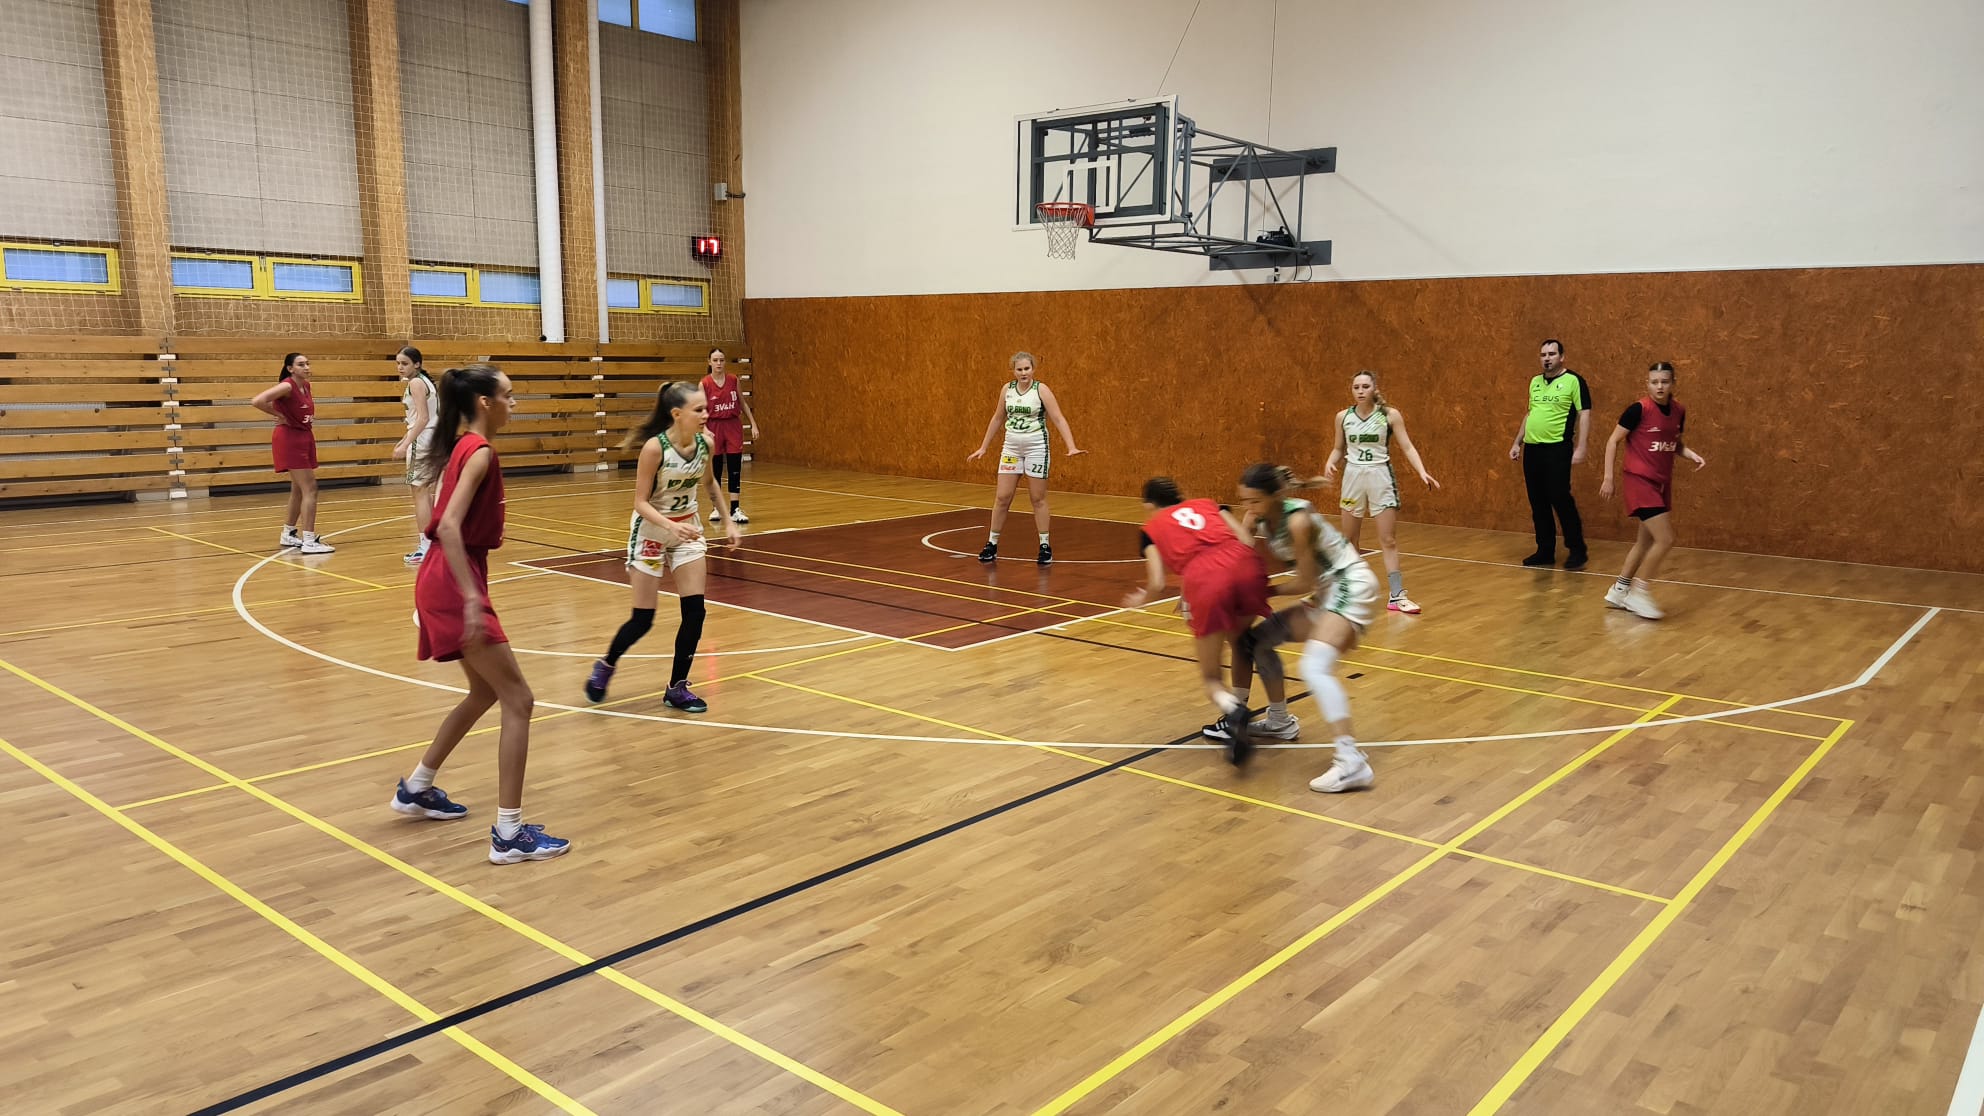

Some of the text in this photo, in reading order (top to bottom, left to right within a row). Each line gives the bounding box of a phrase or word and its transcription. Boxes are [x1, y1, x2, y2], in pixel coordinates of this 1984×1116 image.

[700, 238, 718, 254] 17
[1358, 448, 1373, 461] 26
[1031, 463, 1043, 474] 22
[1171, 507, 1206, 531] 8
